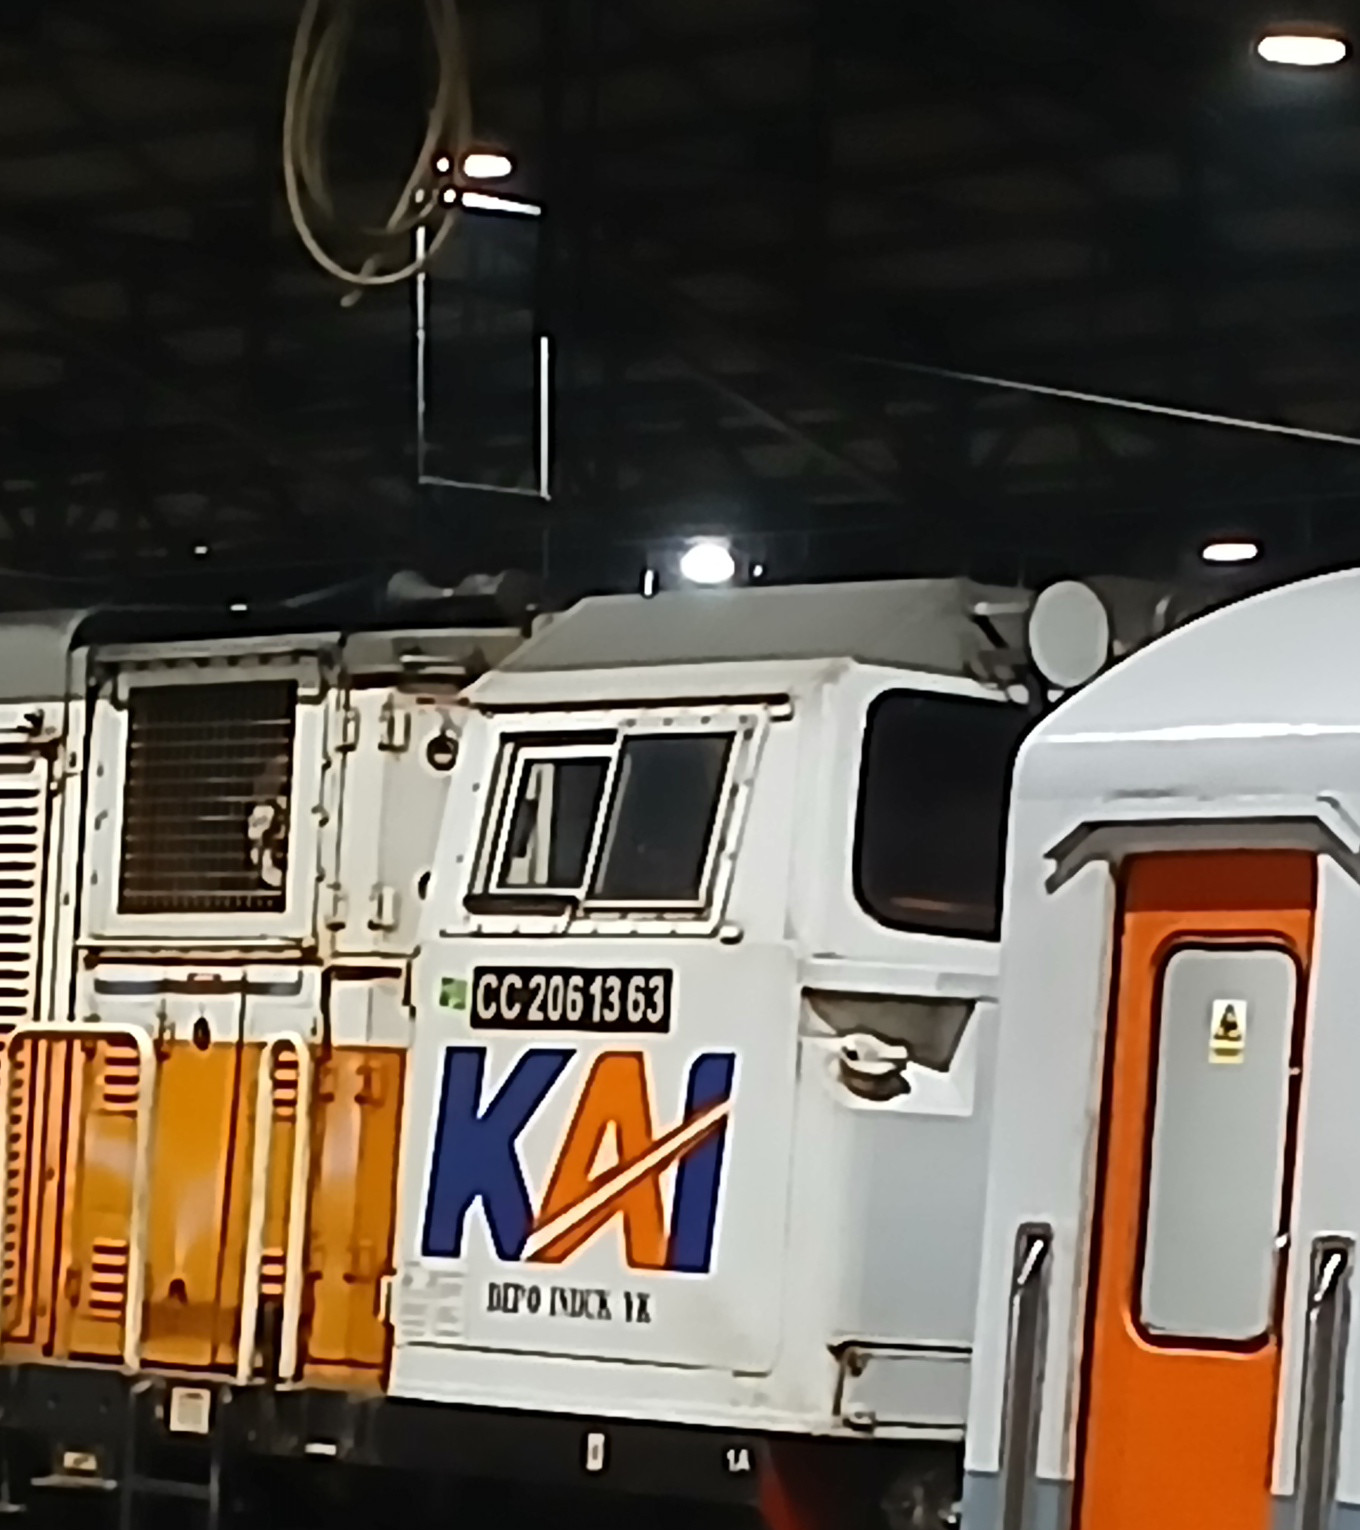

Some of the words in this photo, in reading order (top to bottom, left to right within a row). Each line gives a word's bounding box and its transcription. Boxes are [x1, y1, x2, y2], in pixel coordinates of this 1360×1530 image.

[476, 973, 523, 1020] CC
[421, 1045, 736, 1274] KAI
[486, 1281, 542, 1314] DEPO
